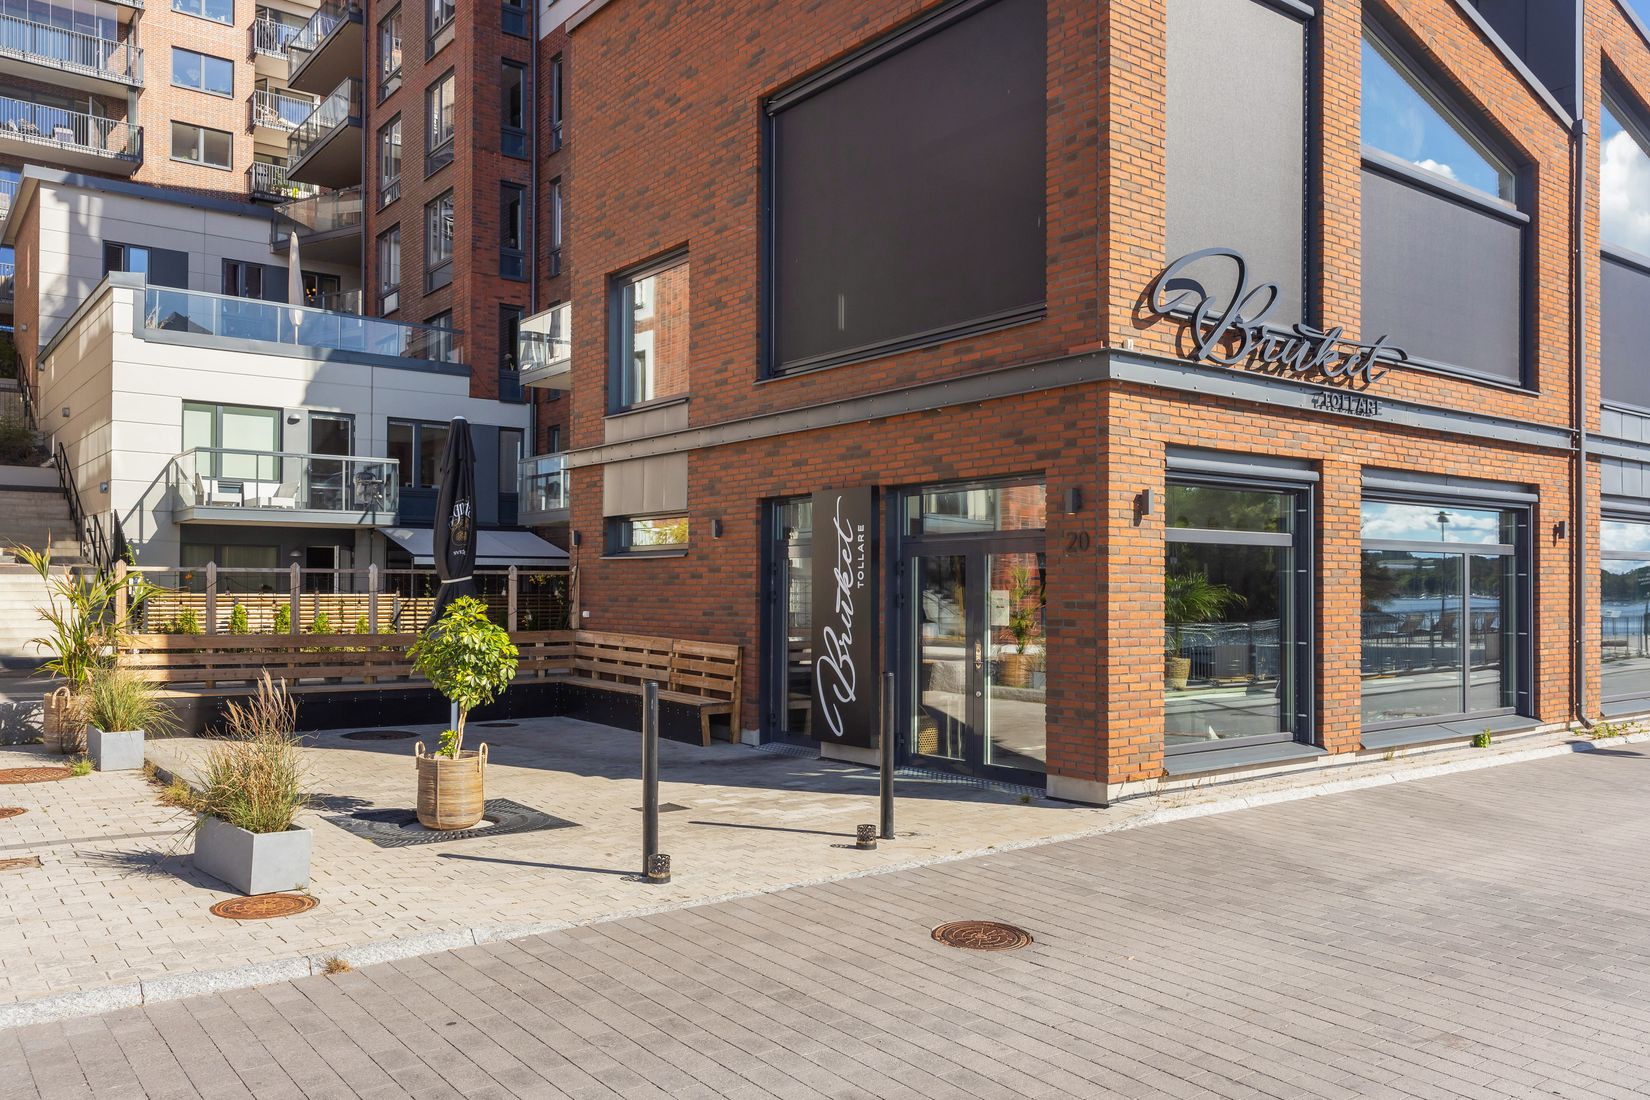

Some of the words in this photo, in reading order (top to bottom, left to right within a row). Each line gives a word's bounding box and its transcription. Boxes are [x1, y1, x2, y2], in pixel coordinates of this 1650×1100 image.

[1149, 247, 1408, 384] Bruket
[1322, 391, 1383, 416] TOLLARE
[857, 524, 865, 588] TOLLARE
[1066, 531, 1089, 552] 20
[816, 495, 856, 737] Bruket
